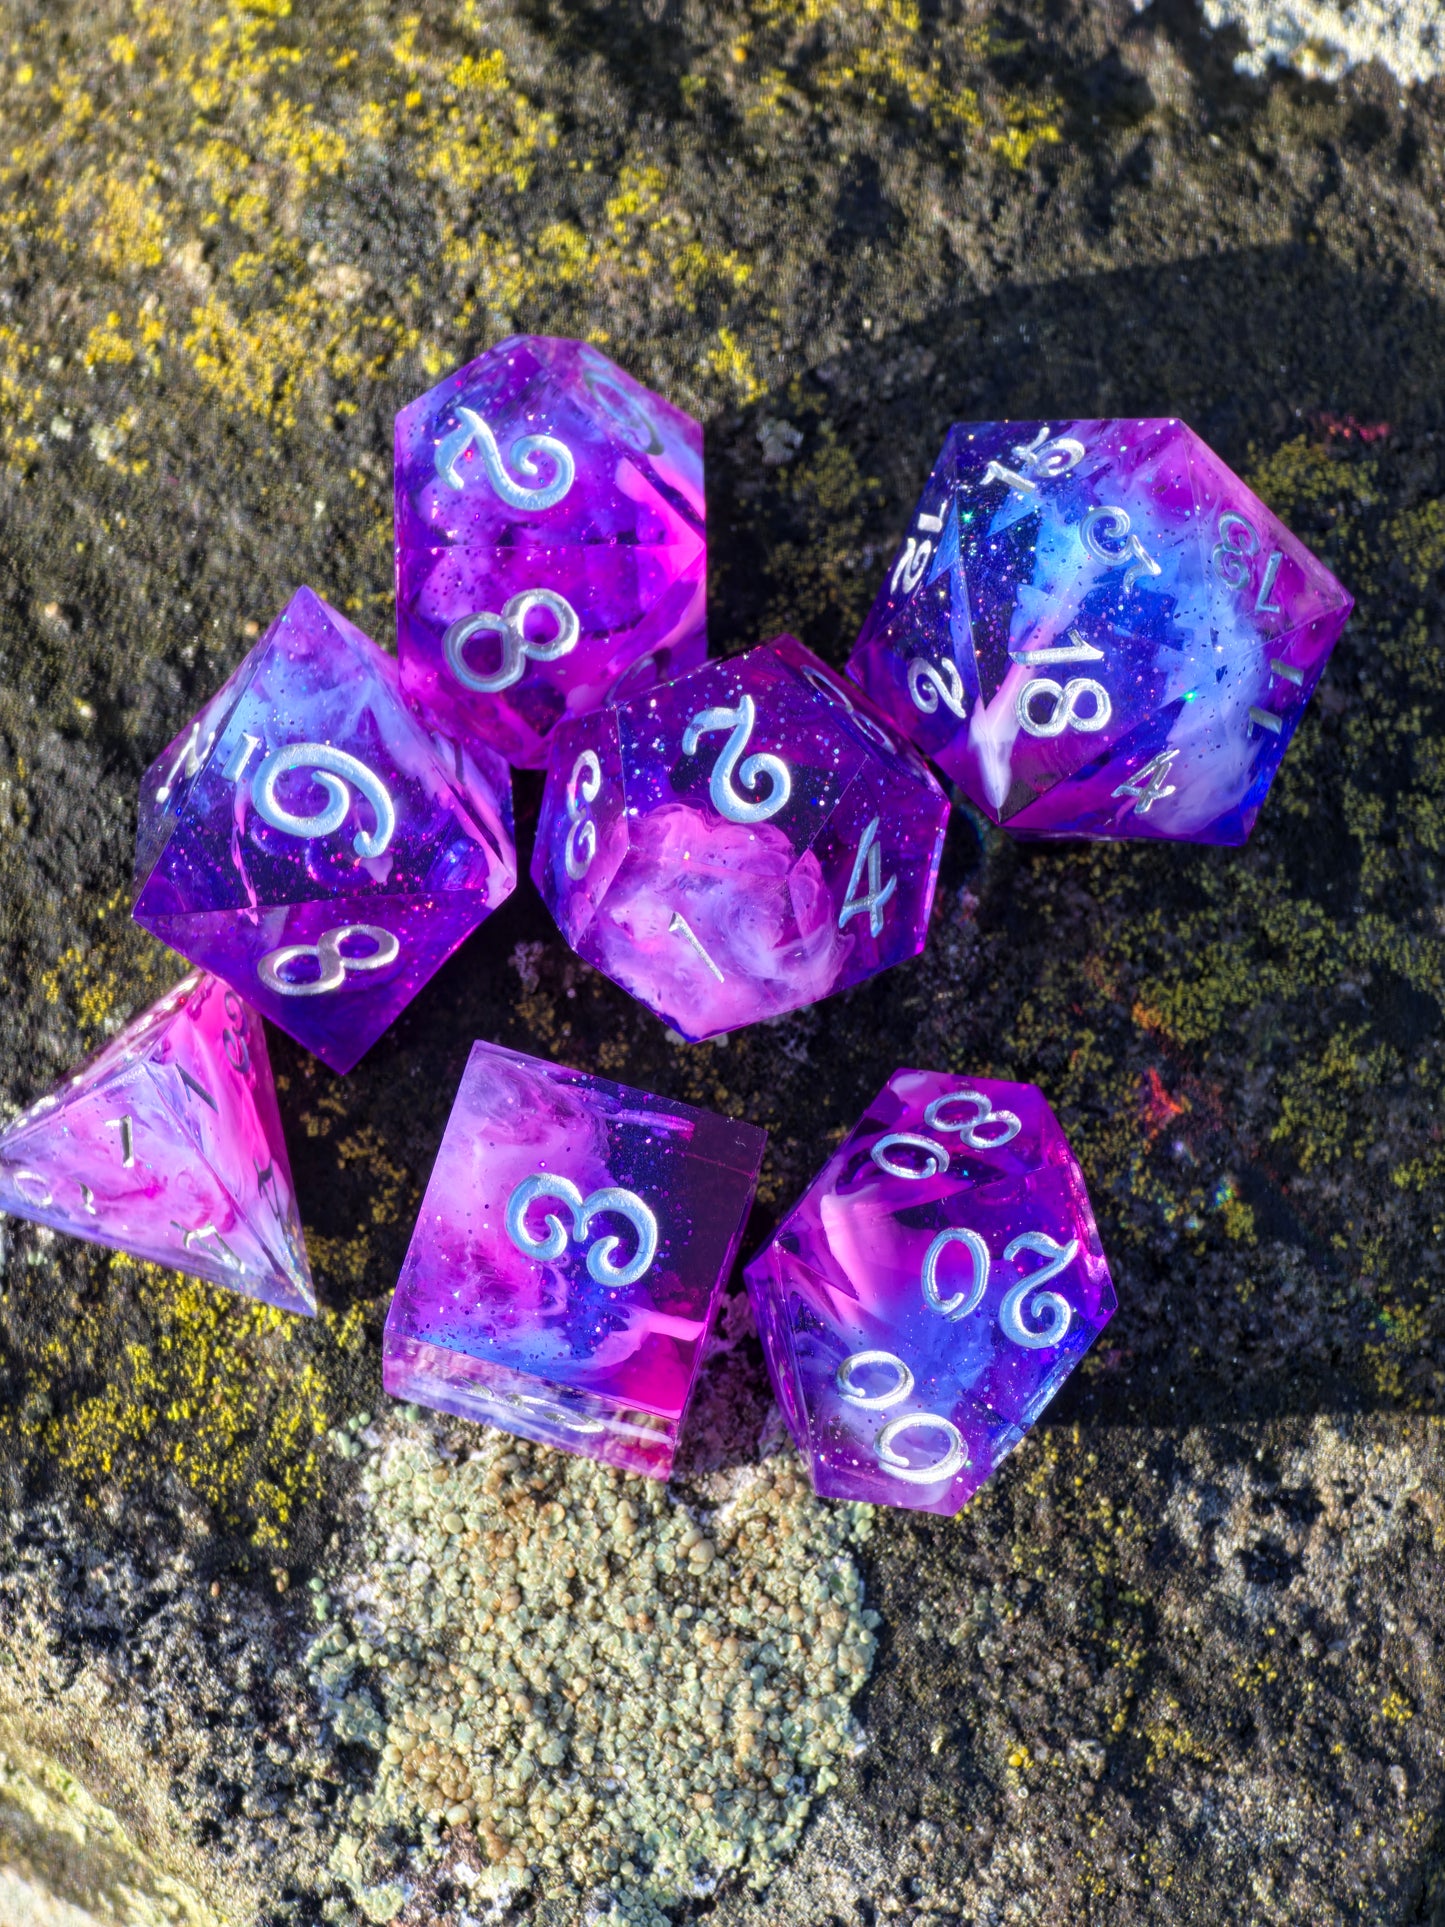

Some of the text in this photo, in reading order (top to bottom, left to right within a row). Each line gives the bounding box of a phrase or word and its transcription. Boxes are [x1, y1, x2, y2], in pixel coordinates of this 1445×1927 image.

[434, 406, 575, 511] 2
[890, 499, 947, 595] 12
[1080, 505, 1161, 594] 5
[1213, 510, 1282, 614] 13
[442, 588, 580, 693] 8
[907, 656, 967, 719] 2
[1009, 629, 1112, 738] 18
[681, 694, 791, 824] 2
[1111, 749, 1181, 814] 4
[565, 749, 601, 881] 3
[838, 816, 897, 938] 4
[257, 924, 399, 996] 8
[669, 911, 724, 983] 1
[105, 1114, 134, 1168] 1
[506, 1172, 658, 1287] 3
